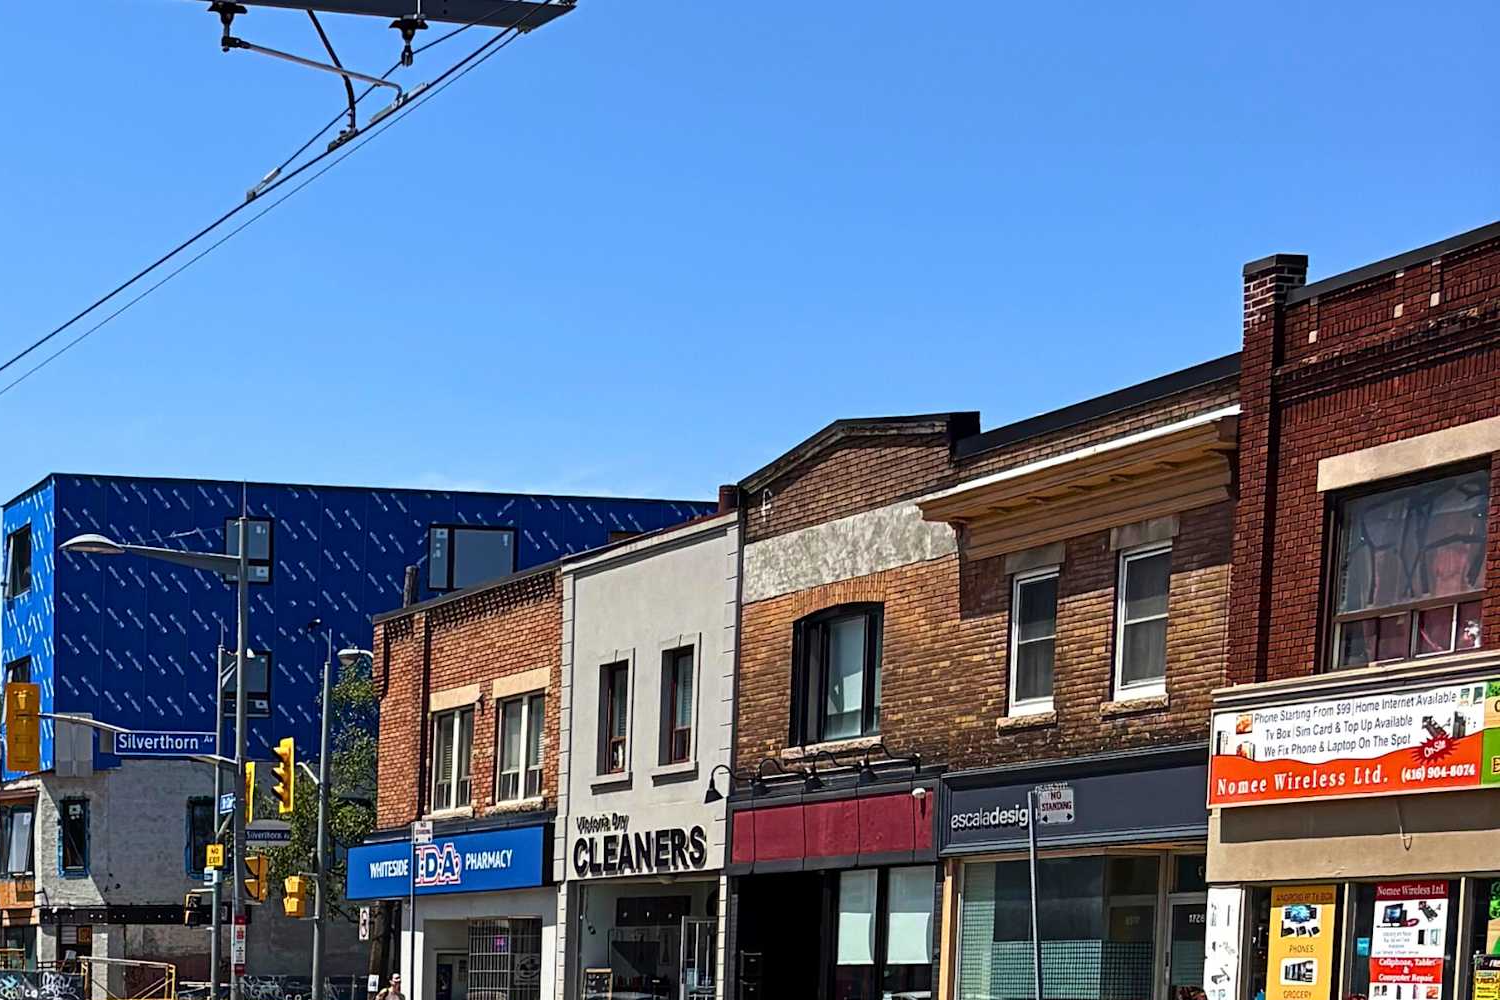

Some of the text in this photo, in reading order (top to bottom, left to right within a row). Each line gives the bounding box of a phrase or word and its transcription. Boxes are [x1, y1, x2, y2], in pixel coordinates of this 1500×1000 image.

[1254, 690, 1457, 724] Phone Starting From $99 Home Internet Available
[1276, 727, 1291, 740] Box
[1295, 724, 1311, 738] Sim
[1313, 722, 1333, 736] Card
[1335, 721, 1341, 733] &
[1344, 720, 1359, 734] Top
[1360, 719, 1373, 732] Up
[1374, 714, 1413, 729] Available
[118, 733, 214, 750] Silverthorn Av
[1264, 733, 1411, 758] We Fix Phone & Laptop On The Spot
[1216, 764, 1389, 796] Nomee Wireless Ltd.
[1051, 791, 1062, 800] NO
[576, 814, 611, 834] Victoria
[209, 856, 220, 864] EXIT
[573, 825, 708, 878] CLEANERS
[369, 858, 409, 879] WHITESIDE
[465, 849, 513, 870] PHARMACY
[1377, 886, 1401, 896] Nomee
[1401, 885, 1431, 895] Wireless
[1288, 944, 1315, 953] PHONES
[1283, 990, 1312, 999] GROCERY
